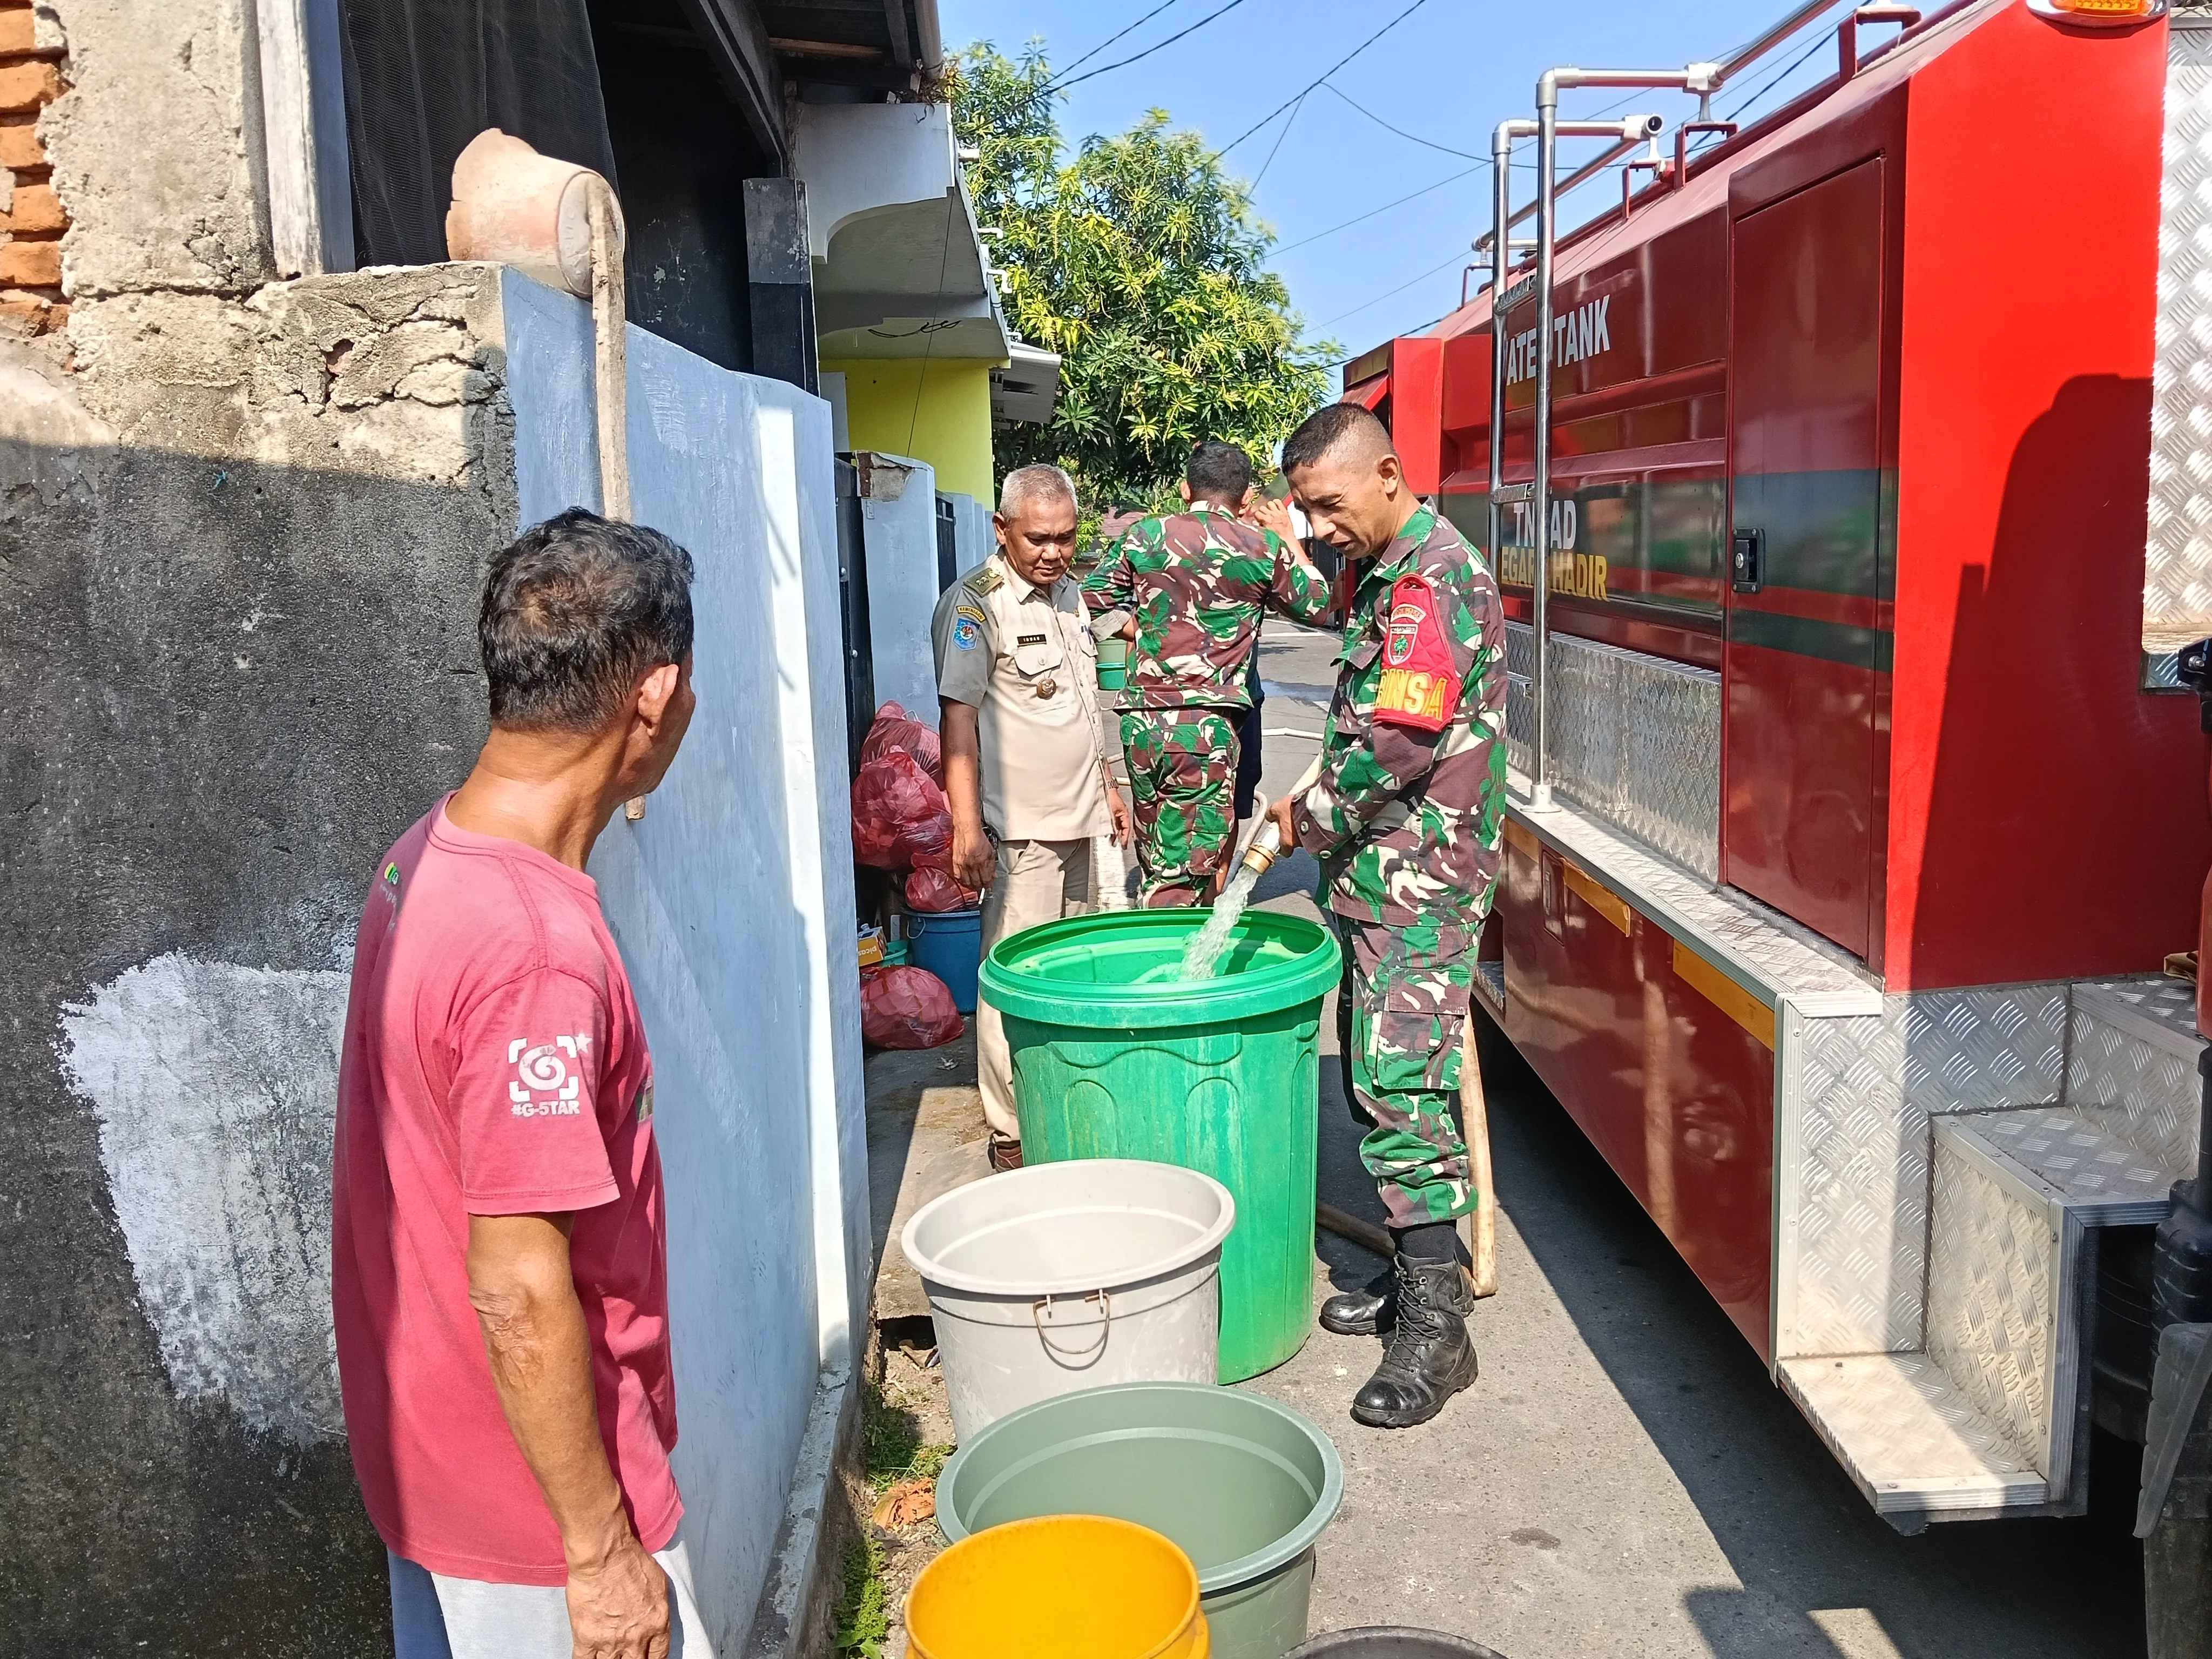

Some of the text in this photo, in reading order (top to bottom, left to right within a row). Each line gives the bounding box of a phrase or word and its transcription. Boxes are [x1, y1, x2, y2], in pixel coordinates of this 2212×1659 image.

[1505, 294, 1610, 386] ATE TANK
[1501, 546, 1608, 599] EGAR HADIR
